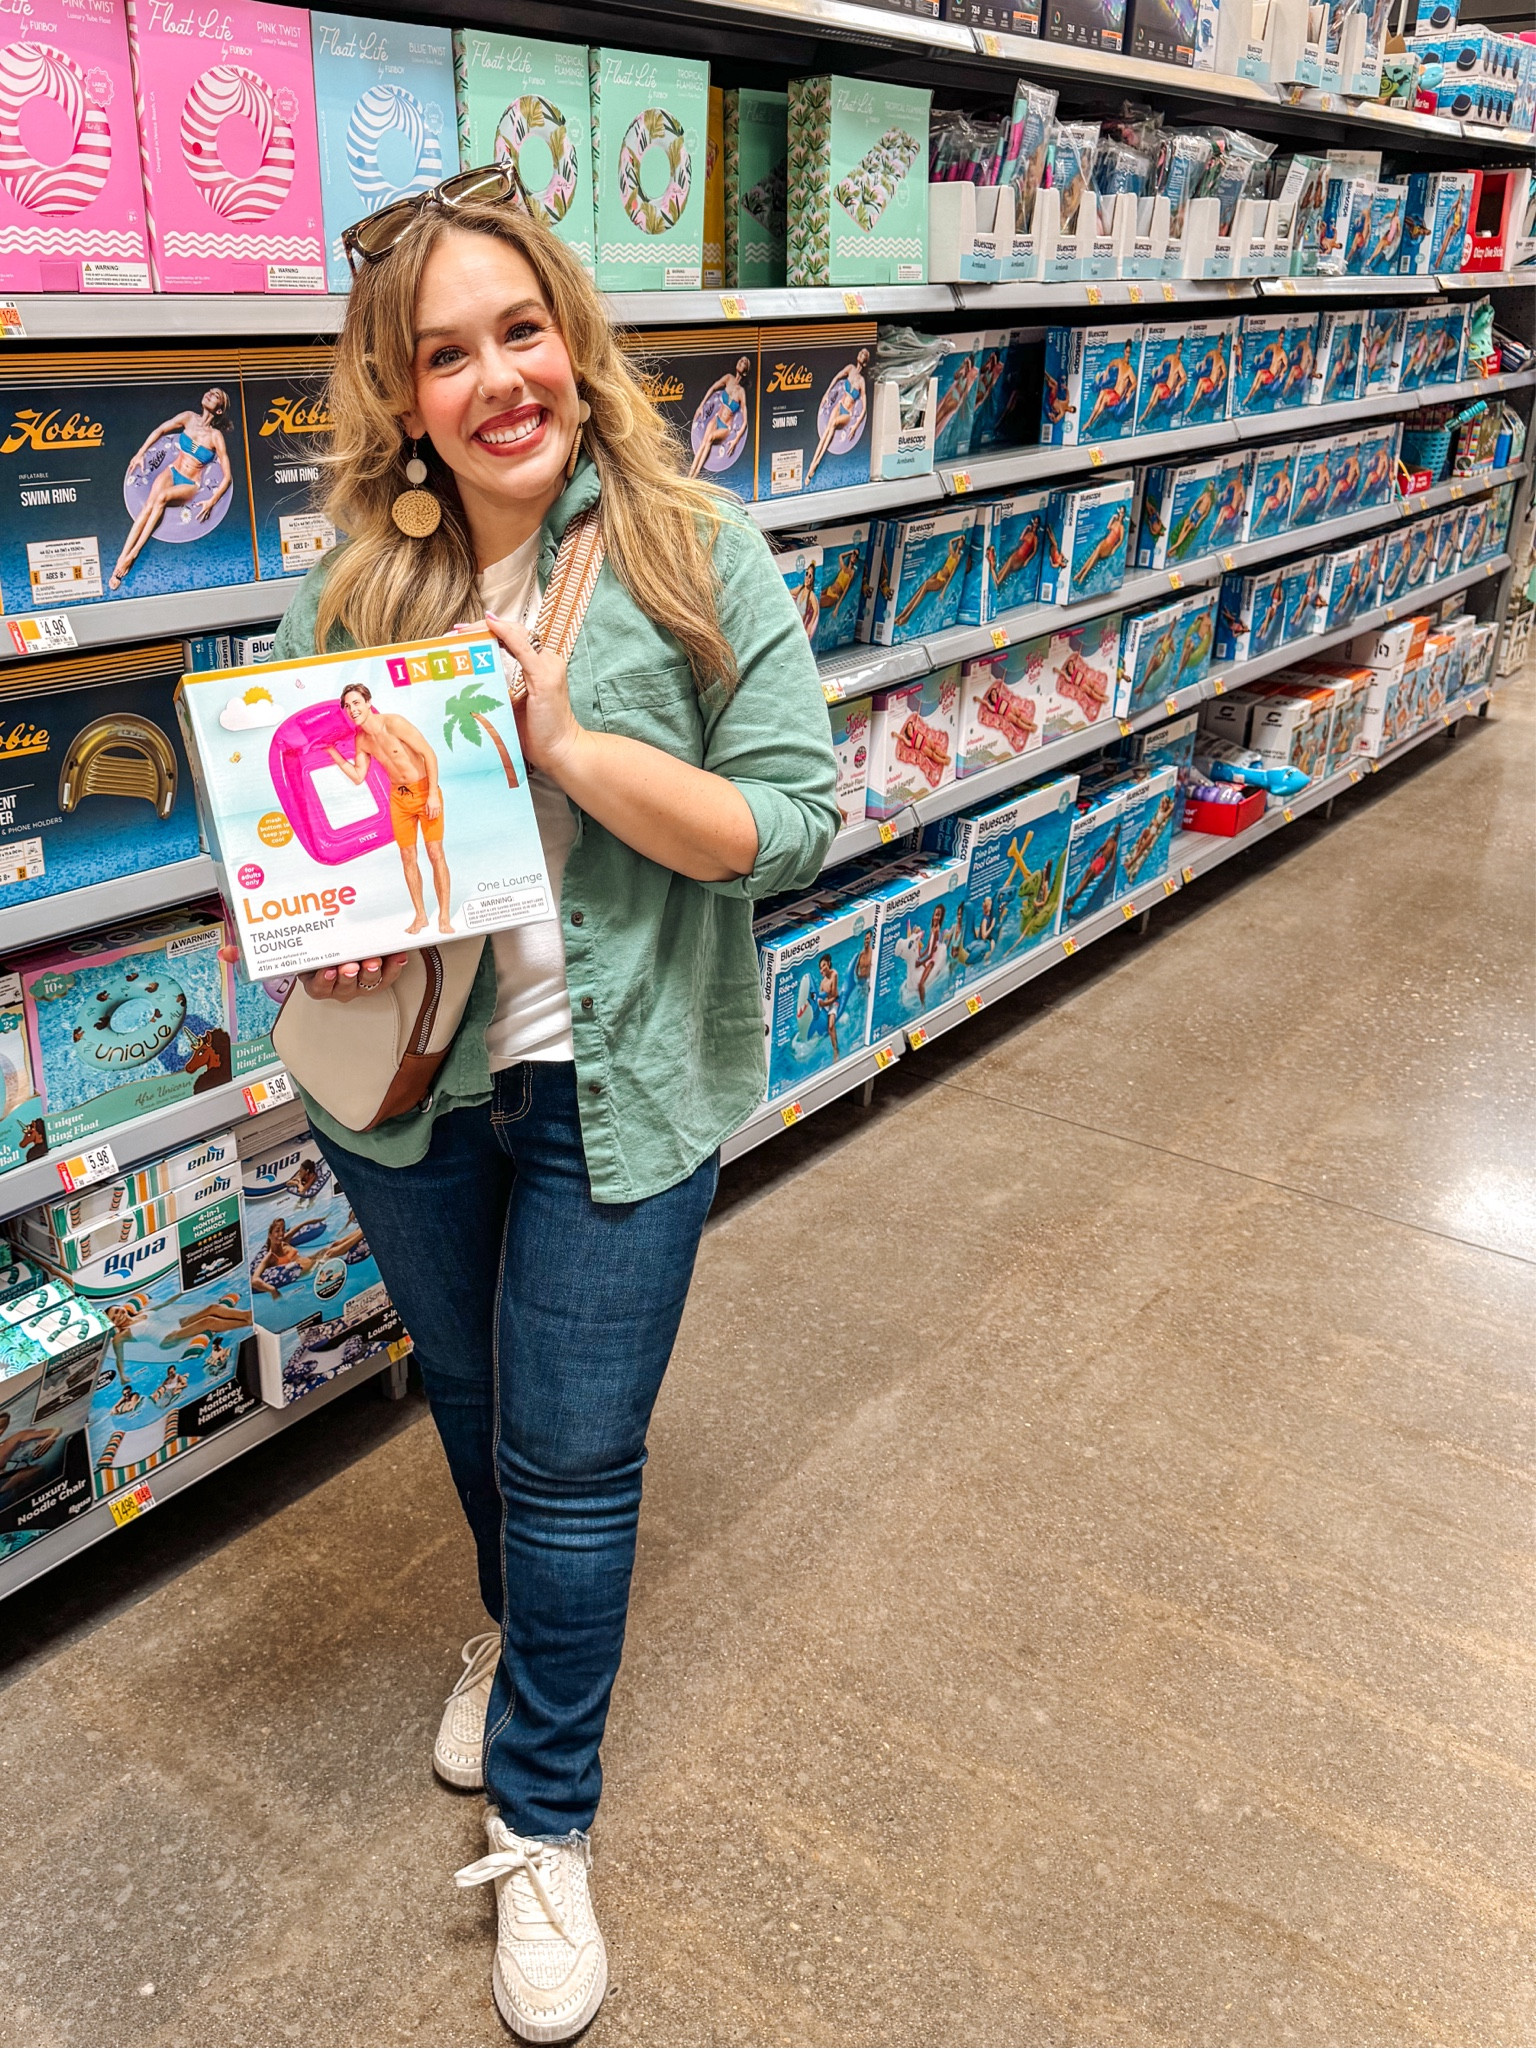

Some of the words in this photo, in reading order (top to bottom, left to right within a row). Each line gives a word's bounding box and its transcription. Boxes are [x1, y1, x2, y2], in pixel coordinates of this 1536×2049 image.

[88, 0, 114, 13] TWIST
[148, 0, 195, 36] Float
[197, 8, 234, 41] Life
[256, 21, 277, 34] PINK
[278, 24, 301, 38] TWIST
[319, 25, 356, 58] Float
[358, 31, 389, 62] Life
[408, 42, 426, 54] BLUE
[427, 45, 446, 57] TWIST
[471, 39, 505, 71] Float
[506, 46, 533, 74] Life
[555, 54, 585, 68] TROPICAL
[554, 65, 586, 79] FLAMINGO
[603, 57, 634, 86] Float
[634, 62, 658, 89] Life
[973, 239, 996, 251] Bluescape
[1012, 240, 1034, 249] Bluescape
[95, 263, 119, 273] WARNING
[278, 267, 300, 275] WARNING
[1075, 331, 1083, 375] Bluescape
[765, 362, 813, 393] Hobie
[258, 396, 337, 437] Hobi
[0, 408, 104, 453] Hobie
[898, 434, 927, 445] Bluescape
[19, 472, 49, 480] INFLATABLE
[274, 469, 299, 484] SWIM
[300, 467, 319, 482] RING
[20, 490, 50, 507] SWIM
[51, 487, 77, 505] RING
[909, 521, 936, 534] Bluescape
[45, 571, 58, 580] AGES
[44, 618, 67, 637] 4.98
[252, 640, 275, 654] Blue
[390, 646, 494, 685] INTEX
[8, 823, 31, 835] PHONE
[32, 816, 63, 829] HOLDERS
[260, 824, 283, 833] bottom
[979, 809, 1018, 834] Bluescape
[359, 832, 378, 844] INTEX
[960, 823, 973, 861] Bluesca
[975, 850, 988, 861] Dino
[987, 841, 1001, 855] Duel
[973, 860, 986, 872] Pool
[985, 853, 1001, 867] Game
[241, 872, 262, 881] adults
[477, 881, 500, 892] One
[502, 872, 543, 888] Lounge
[243, 886, 357, 925] Lounge
[886, 888, 921, 913] Bluescape
[250, 918, 336, 943] TRANSPARENT
[882, 930, 901, 945] Ride-on
[883, 921, 901, 935] Unicorn
[178, 930, 219, 947] WARNING:
[253, 936, 304, 955] LOUNGE
[780, 935, 821, 962] Bluescape
[280, 959, 297, 969] 40in
[765, 952, 774, 1001] Bluescape
[779, 972, 794, 986] Shark
[44, 981, 64, 994] 10+
[778, 979, 799, 996] Ride-on
[236, 1043, 265, 1059] Divine
[236, 1056, 257, 1070] Ring
[257, 1051, 278, 1063] Floa
[268, 1077, 287, 1095] 5.98
[47, 1112, 84, 1131] Unique
[48, 1130, 73, 1144] Ring
[74, 1119, 99, 1135] Float
[0, 1149, 19, 1167] Ball
[88, 1149, 110, 1169] 5.98
[187, 1146, 225, 1171] Aqua
[255, 1151, 301, 1180] Aqua
[194, 1177, 231, 1201] Aqua
[192, 1211, 227, 1232] MONTEREY
[198, 1206, 220, 1221] 4-in-1
[194, 1219, 227, 1238] HAMMOCK
[104, 1236, 167, 1276] Aqua
[383, 1309, 398, 1322] 3-in
[367, 1317, 398, 1340] Lounge
[199, 1386, 242, 1416] Monterey
[206, 1381, 233, 1402] 4-in-1
[198, 1394, 244, 1426] Hammock
[17, 1500, 57, 1526] Noodle
[58, 1477, 86, 1501] Chair
[31, 1480, 69, 1508] Luxury
